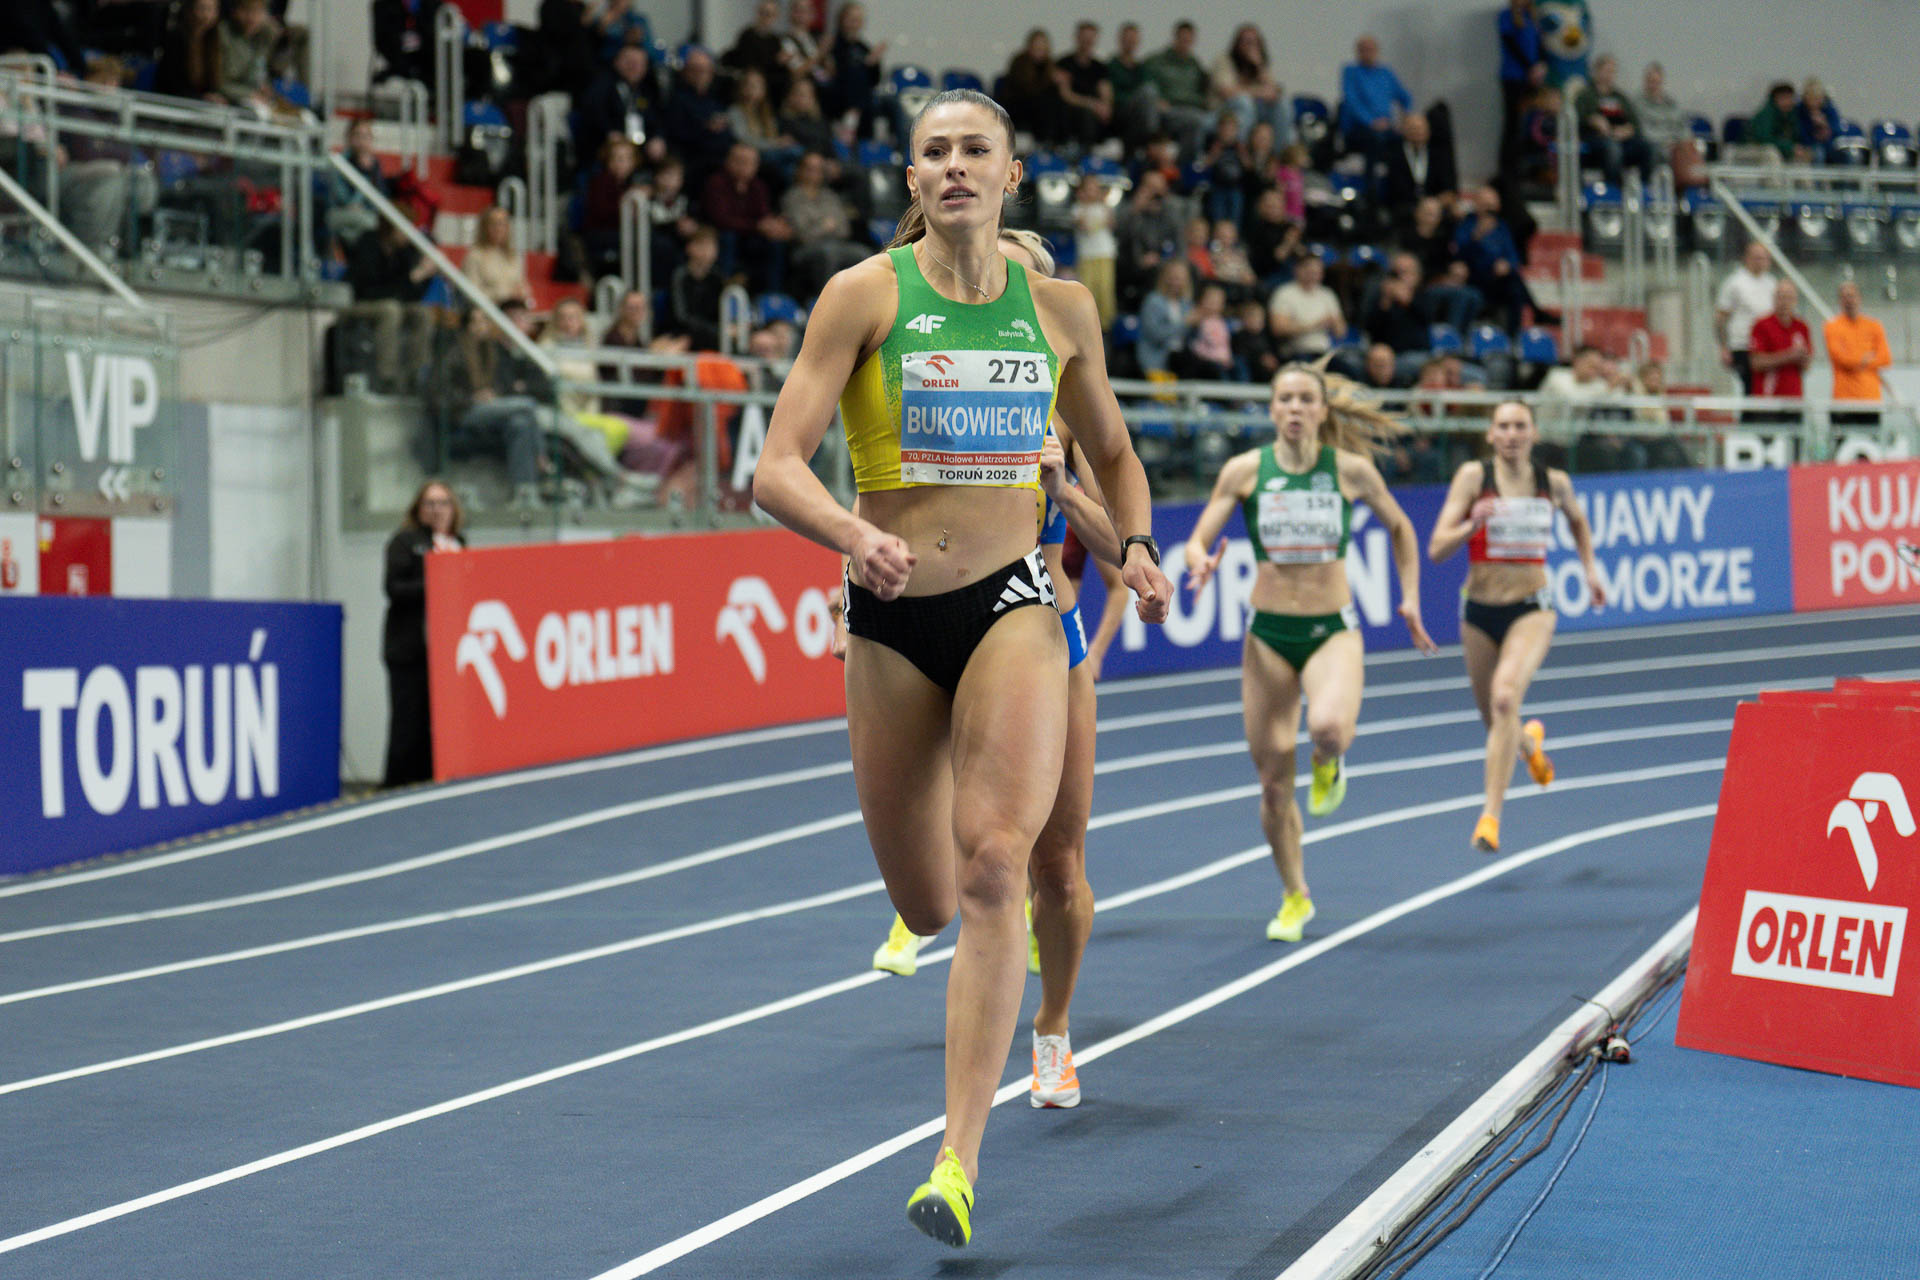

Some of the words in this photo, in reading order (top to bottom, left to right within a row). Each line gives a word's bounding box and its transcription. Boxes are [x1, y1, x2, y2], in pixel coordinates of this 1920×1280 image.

[905, 313, 947, 335] 4F
[922, 378, 959, 388] ORLEN
[988, 358, 1039, 384] 273
[65, 351, 159, 464] VIP
[907, 405, 1043, 437] BUKOWIECKA
[921, 453, 941, 463] PZLA
[943, 454, 973, 464] Halowe
[975, 455, 1023, 464] Mistrzostwa
[938, 467, 983, 481] TORUŃ
[986, 469, 1017, 480] 2026
[1542, 484, 1714, 550] UJAWY
[1828, 474, 1920, 532] KUJ
[535, 603, 674, 690] ORLEN
[23, 629, 279, 818] TORUŃ
[1747, 906, 1893, 979] ORLEN
